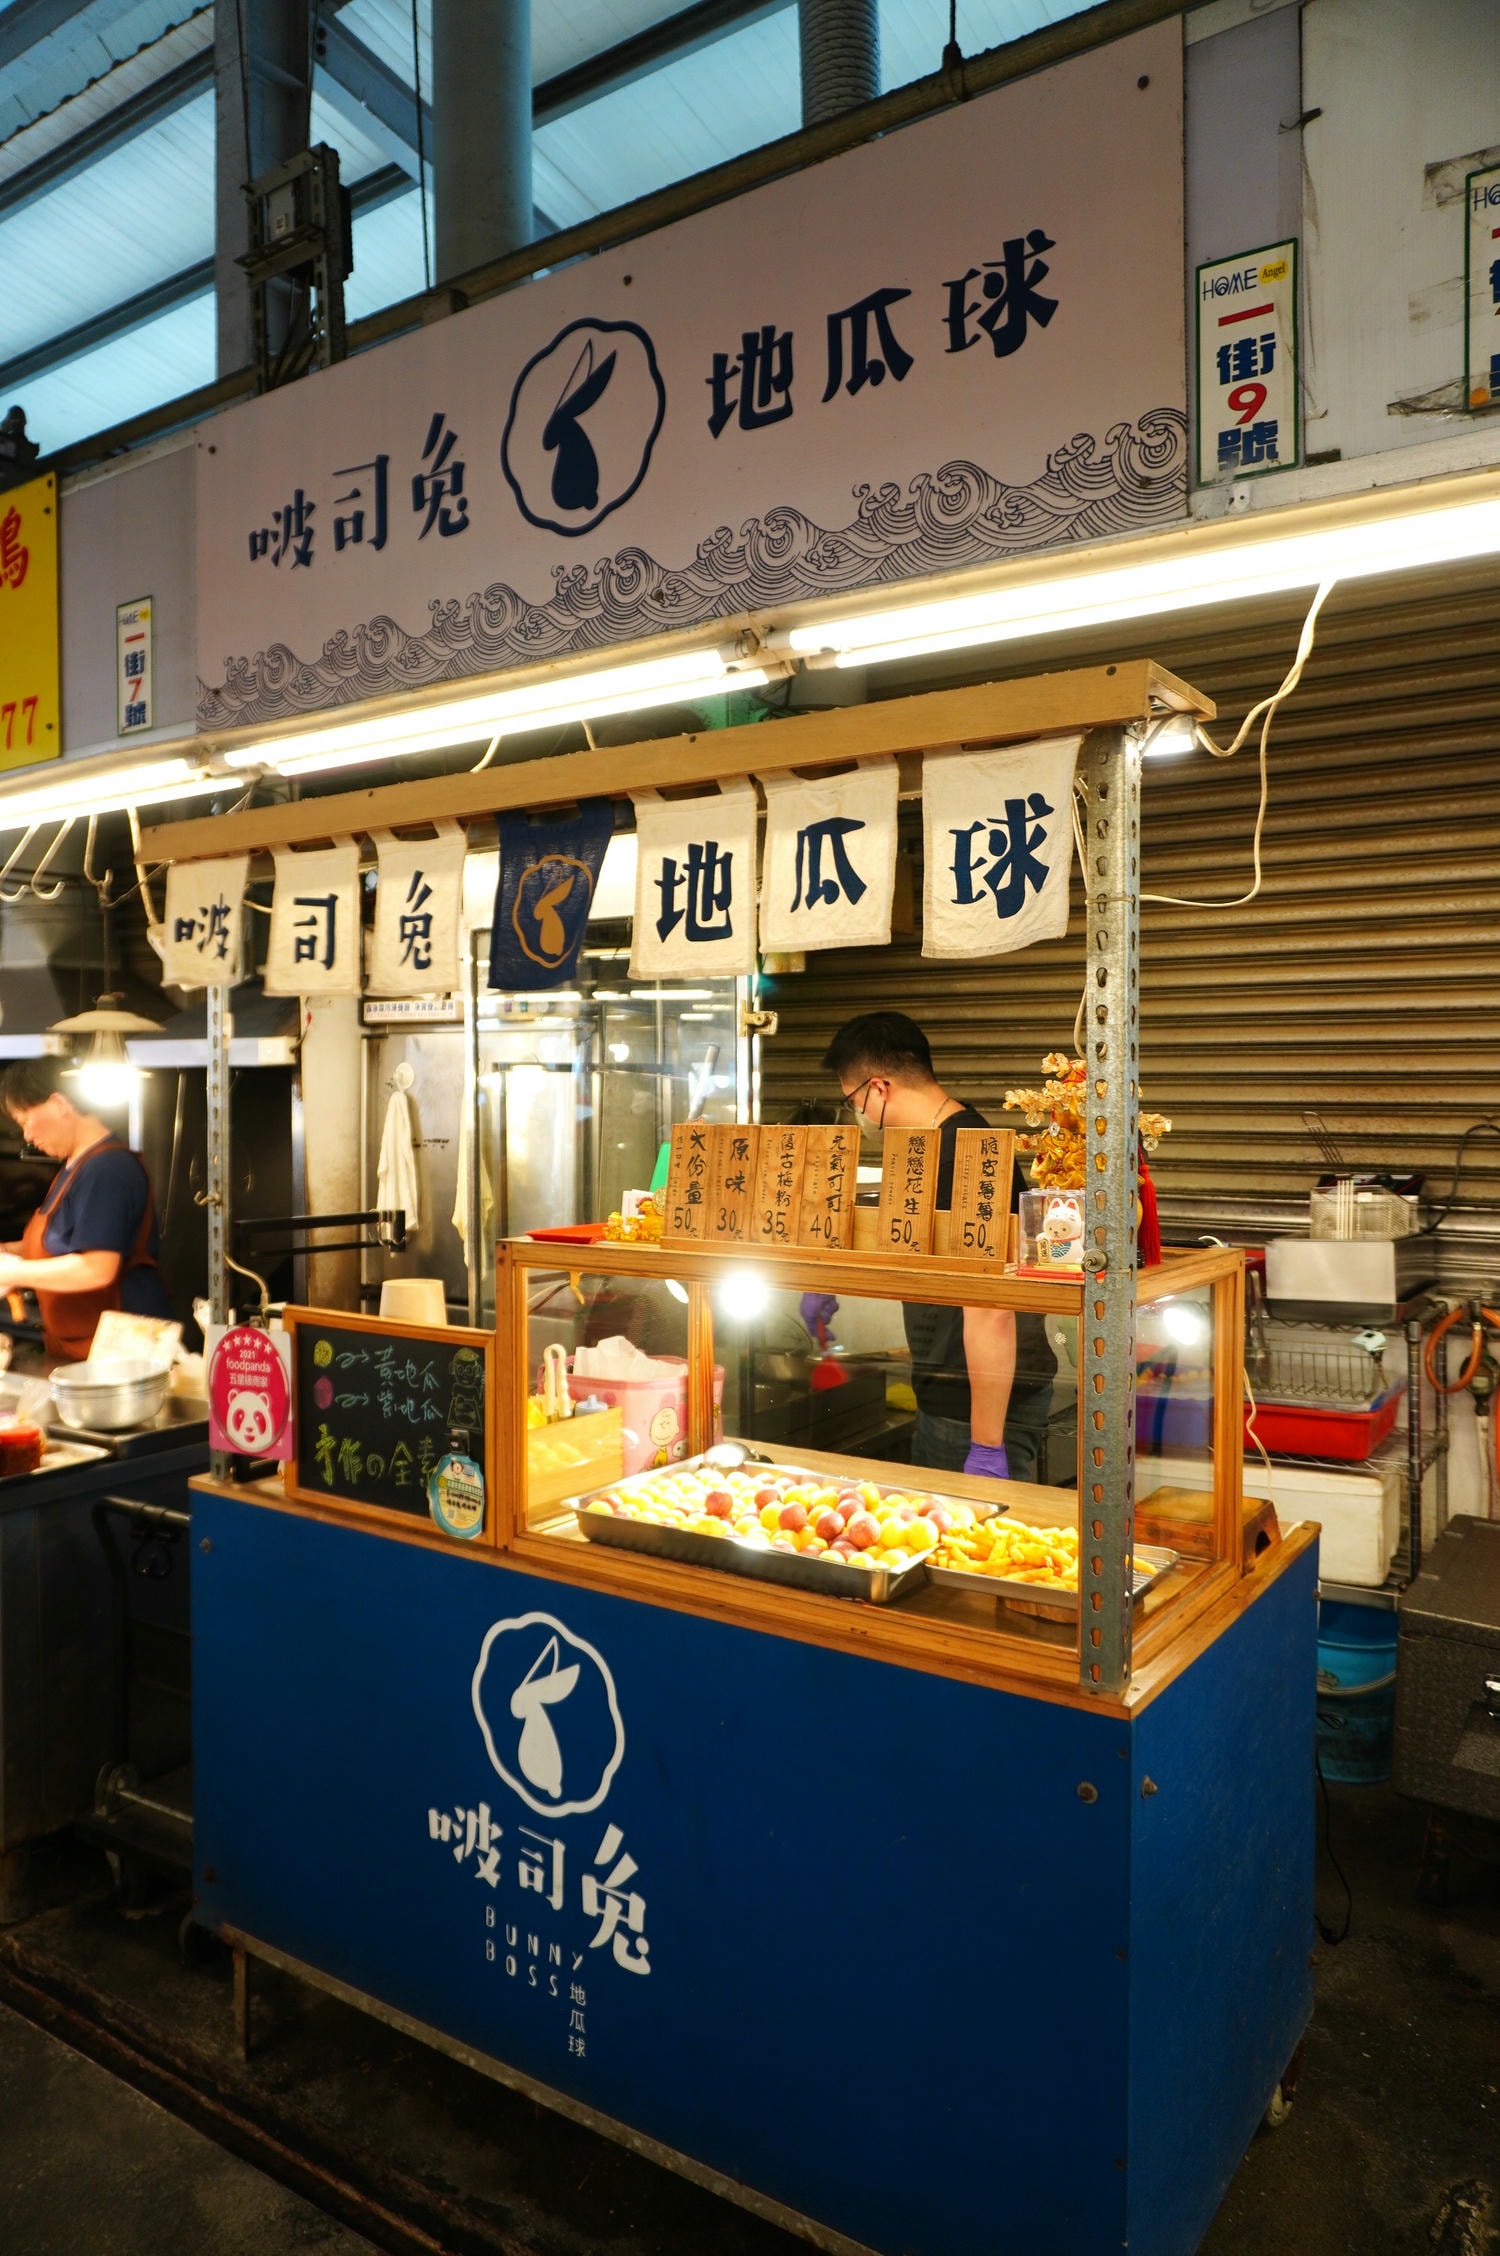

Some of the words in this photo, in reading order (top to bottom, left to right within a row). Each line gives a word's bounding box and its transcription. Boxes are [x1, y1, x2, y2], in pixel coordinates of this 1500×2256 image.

[1203, 268, 1258, 301] HOME
[1262, 263, 1286, 279] Angel
[249, 412, 470, 569] 啵司兔
[705, 228, 1059, 439] 地瓜球
[1217, 303, 1279, 471] 一街9號
[125, 633, 146, 728] 一街7號
[174, 870, 434, 970] 啵司兔
[654, 792, 1054, 943] 地瓜球
[685, 1129, 706, 1205] 大份量
[725, 1138, 749, 1195] 原味
[826, 1135, 846, 1213] 元氣可可
[904, 1135, 926, 1215] 戀戀花生
[976, 1136, 999, 1222] 脆皮薯薯
[226, 1357, 271, 1373] foodpanda
[239, 1349, 256, 1359] 2021
[377, 1390, 444, 1424] 紫地瓜
[428, 1801, 651, 1976] 啵司兔
[486, 1905, 583, 1971] BUNNY
[486, 1940, 558, 1997] BOSS
[568, 1982, 587, 2058] 地瓜球
